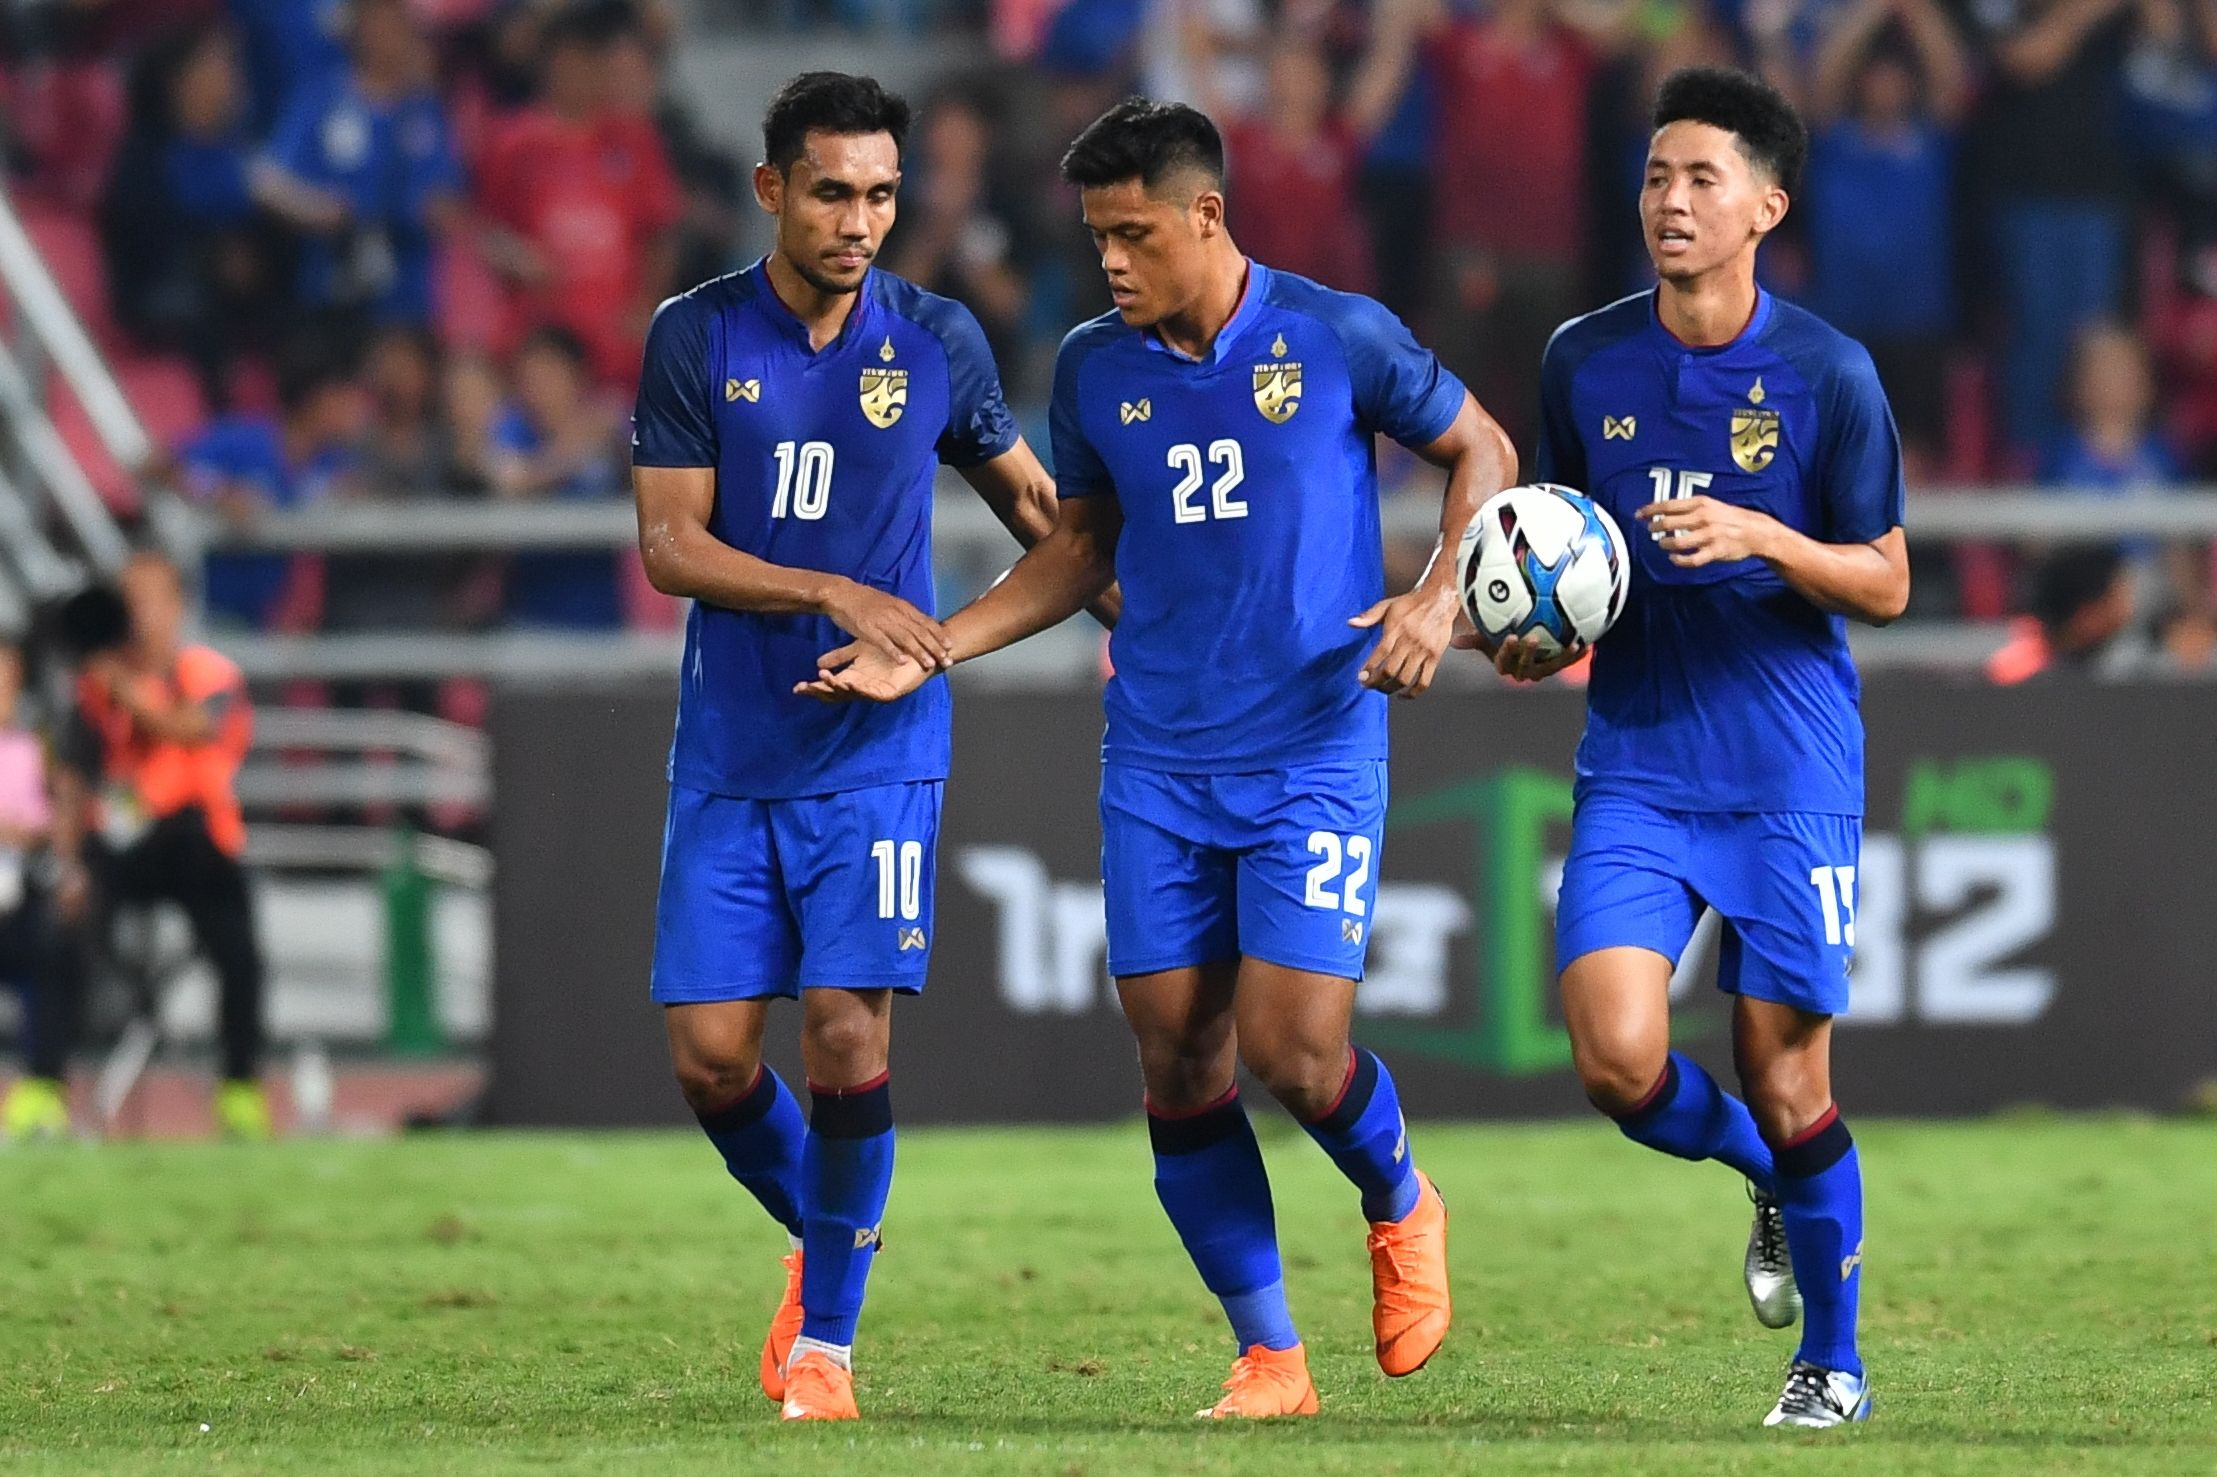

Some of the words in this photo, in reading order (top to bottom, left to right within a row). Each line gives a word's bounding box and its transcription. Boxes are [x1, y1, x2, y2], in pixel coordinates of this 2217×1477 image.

[772, 441, 834, 520] 10
[1167, 439, 1248, 523] 22
[871, 840, 922, 920] 10
[1304, 830, 1372, 917] 22
